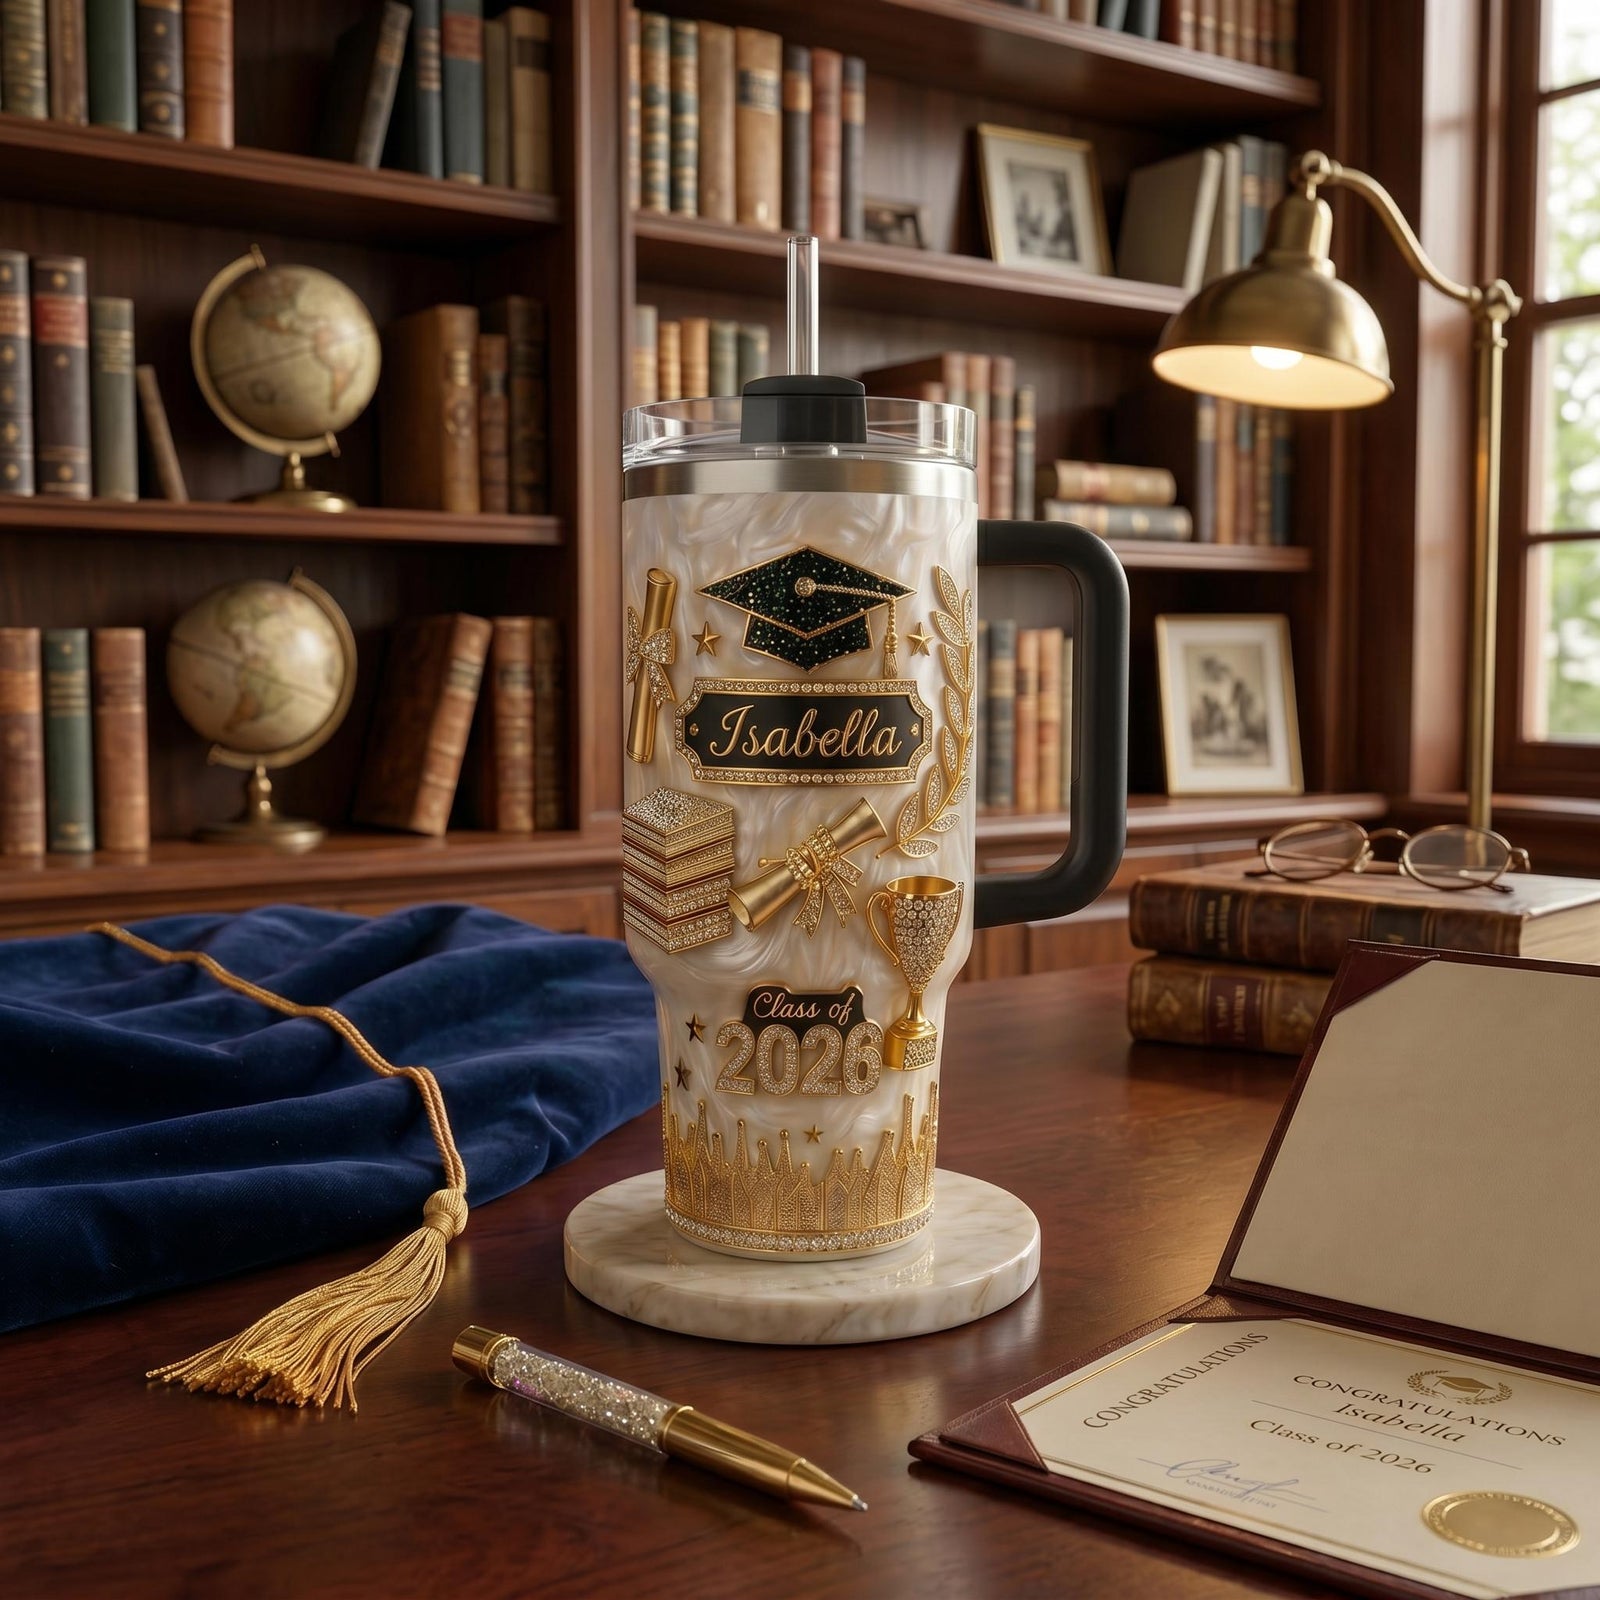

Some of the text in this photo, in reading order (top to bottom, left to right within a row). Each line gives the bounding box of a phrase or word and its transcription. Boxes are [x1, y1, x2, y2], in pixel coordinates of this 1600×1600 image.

[709, 704, 902, 757] Isabella
[753, 991, 856, 1026] Class of
[715, 1020, 884, 1097] 2026
[1083, 1332, 1269, 1429] CONGRATULATIONS
[1293, 1374, 1566, 1446] CONGRATULATIONS
[1333, 1402, 1466, 1443] Isabella
[1250, 1420, 1436, 1474] Class of 2026
